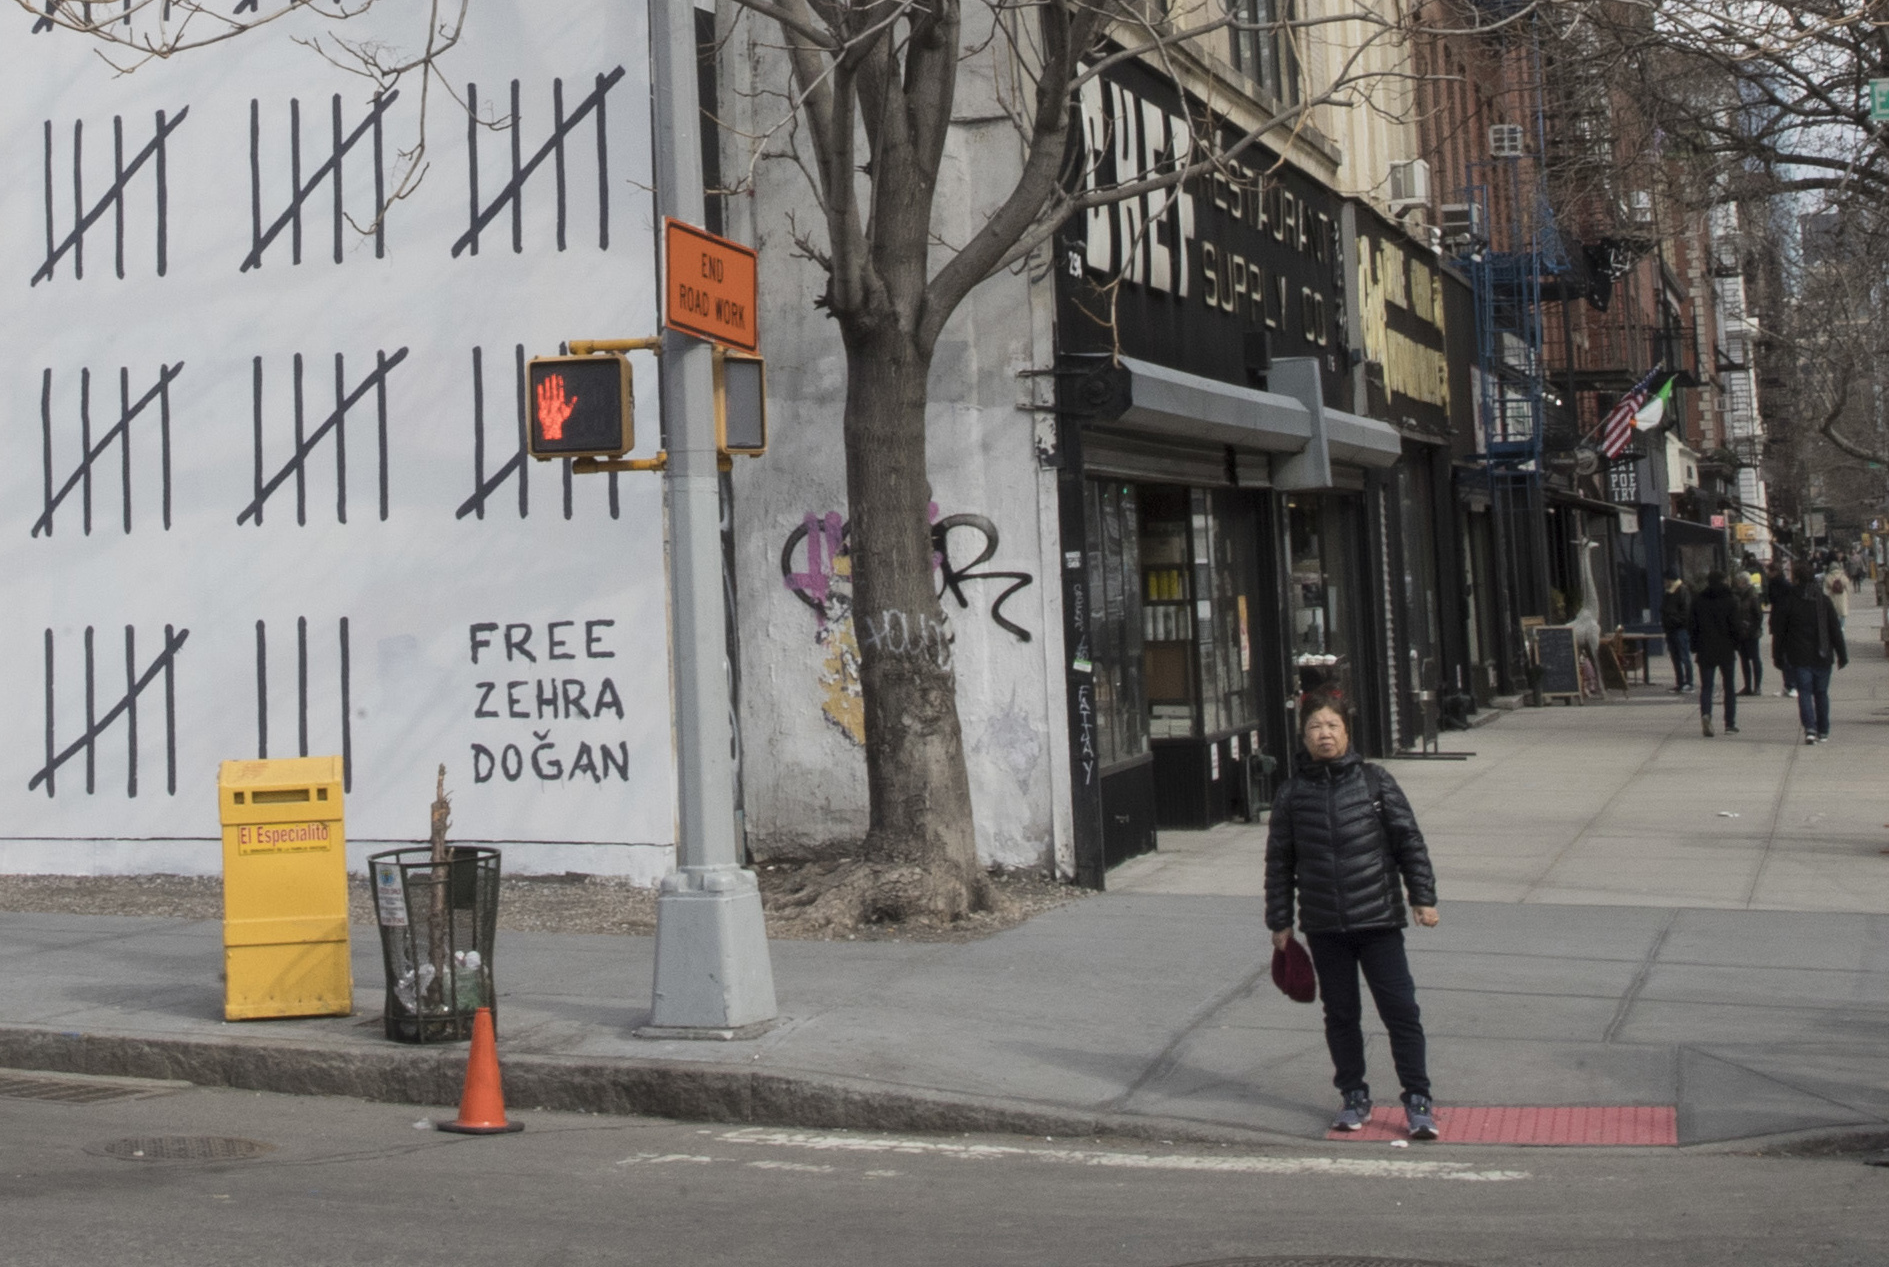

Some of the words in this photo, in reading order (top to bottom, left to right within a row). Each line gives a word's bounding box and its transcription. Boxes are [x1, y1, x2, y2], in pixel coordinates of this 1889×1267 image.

[1076, 60, 1195, 299] CHEF
[701, 253, 724, 283] END
[679, 284, 709, 317] ROAD
[715, 297, 746, 330] WORK
[1201, 240, 1287, 332] SUPPLY
[1301, 285, 1328, 347] CO
[1610, 472, 1637, 488] POE
[1611, 487, 1637, 502] TRY
[469, 619, 615, 665] FREE
[473, 677, 625, 720] ZEHRA
[470, 729, 629, 784] DOĞAN
[240, 826, 252, 845] El
[256, 823, 329, 847] Especialito
